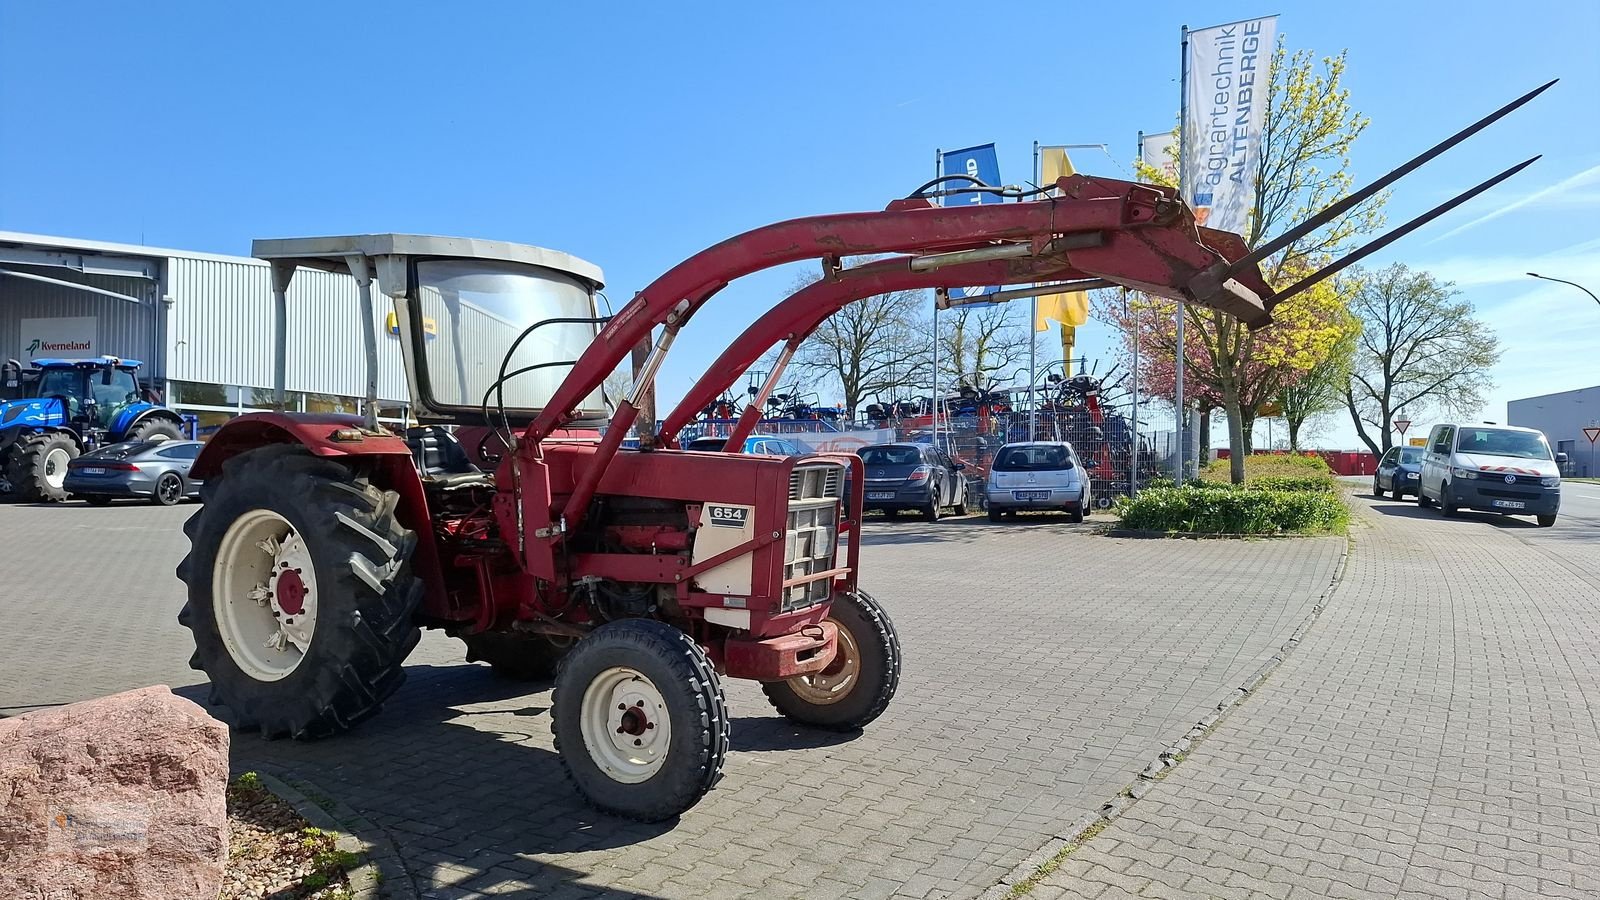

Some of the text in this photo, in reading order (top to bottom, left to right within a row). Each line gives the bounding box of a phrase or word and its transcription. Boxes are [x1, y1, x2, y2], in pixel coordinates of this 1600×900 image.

[1206, 25, 1237, 185] agrartechnik
[1230, 21, 1261, 184] ALTENBERGE
[41, 340, 91, 352] Kverneland
[714, 508, 742, 519] 654
